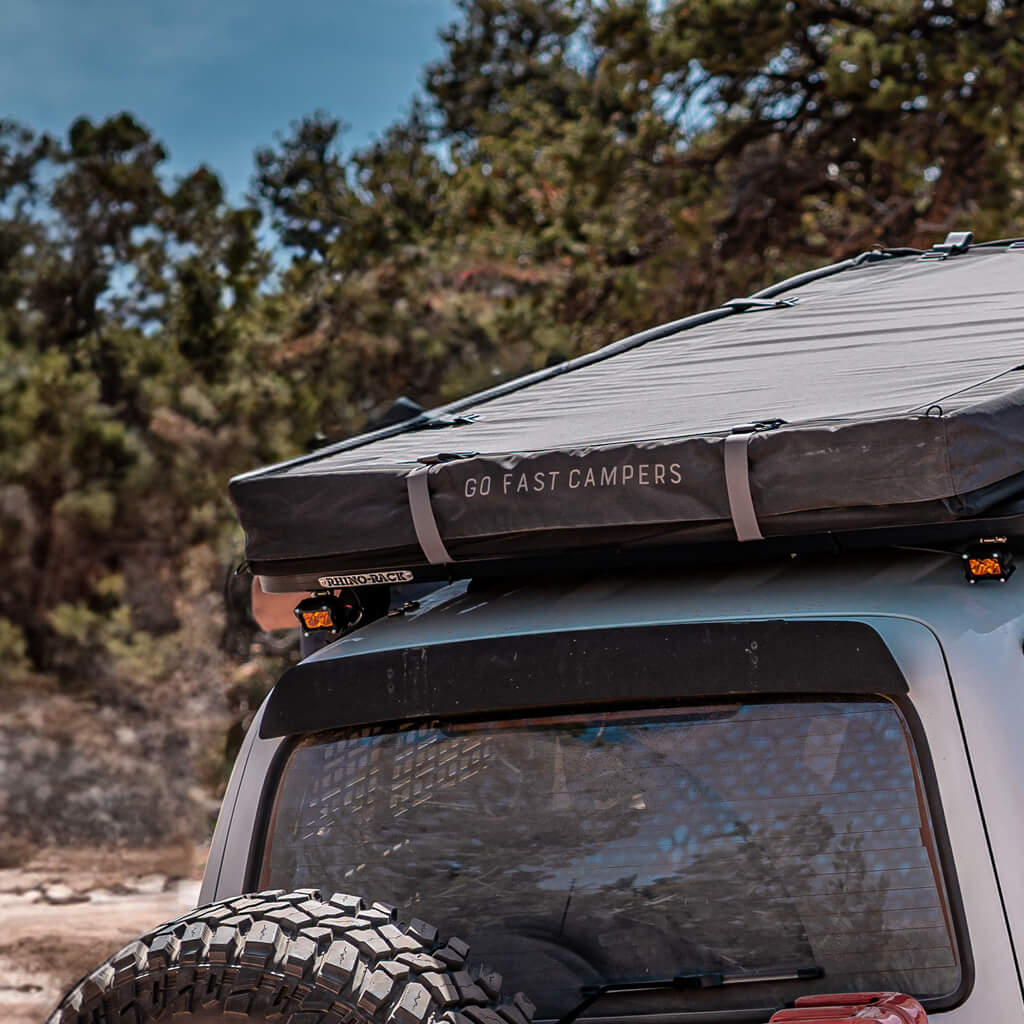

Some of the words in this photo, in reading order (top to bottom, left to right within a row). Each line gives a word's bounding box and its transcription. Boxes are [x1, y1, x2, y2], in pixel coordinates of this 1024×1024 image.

[464, 475, 491, 498] GO
[503, 471, 560, 495] FAST
[568, 463, 682, 489] CAMPERS
[327, 571, 407, 587] RHINO-RACK
